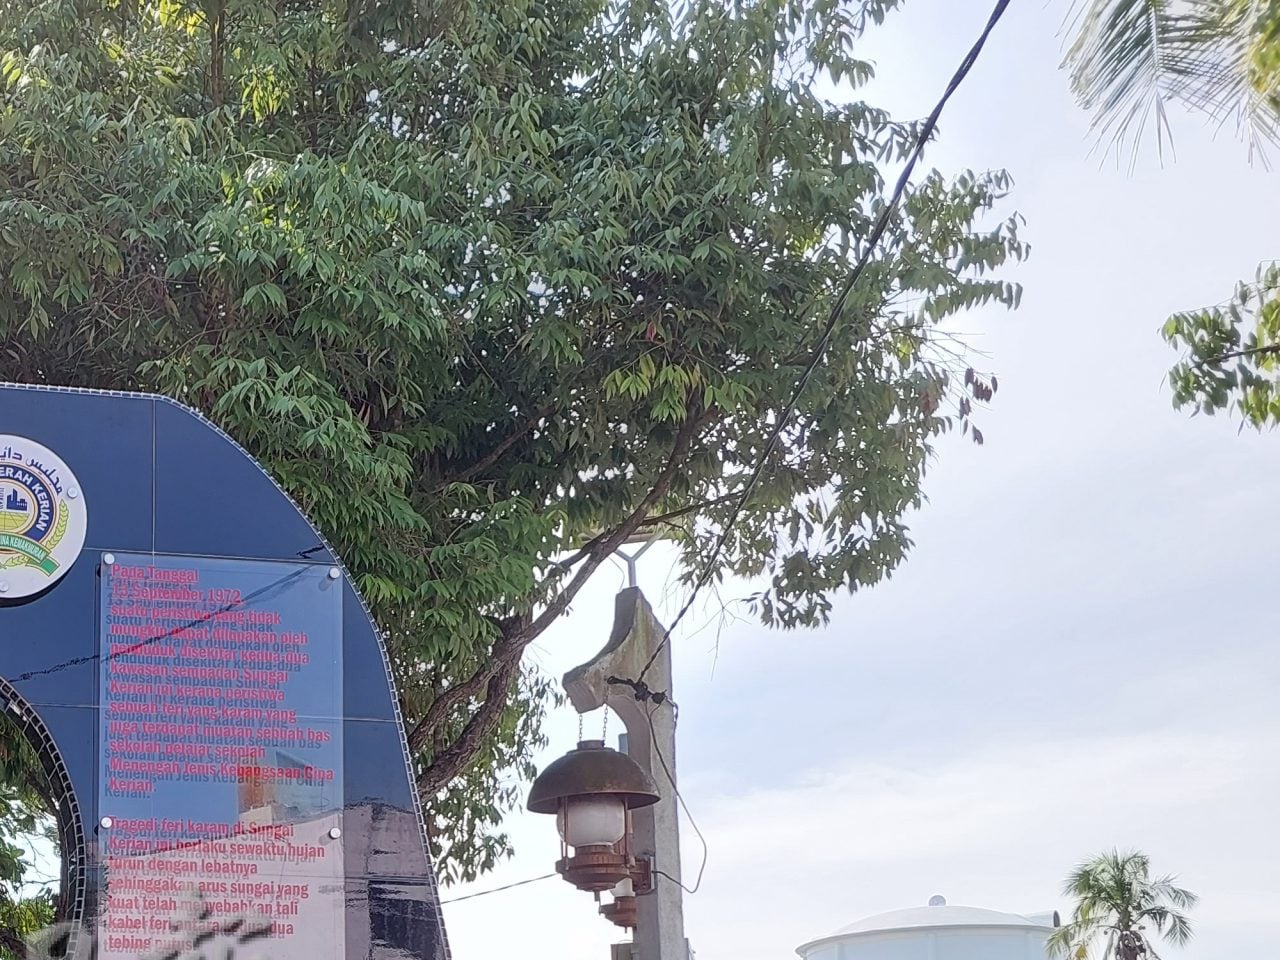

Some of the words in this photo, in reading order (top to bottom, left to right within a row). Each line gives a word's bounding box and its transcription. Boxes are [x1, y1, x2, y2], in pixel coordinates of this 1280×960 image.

[30, 482, 50, 532] KERIAN
[112, 564, 144, 579] Pada
[148, 566, 198, 583] Tanggal
[132, 584, 204, 601] September
[208, 589, 241, 604] 1972
[111, 605, 147, 617] suatu
[249, 610, 281, 624] tidak
[111, 625, 166, 640] mungkin
[213, 628, 276, 644] dilupakan
[281, 631, 308, 644] oleh
[181, 645, 237, 660] disekitar
[241, 650, 309, 664] kedua-dua
[111, 662, 168, 676] kawasan
[172, 666, 240, 680] sempadan
[244, 667, 288, 684] Sungai
[111, 681, 152, 695] Kerian
[158, 682, 173, 696] ini
[177, 684, 221, 698] kerana
[226, 687, 285, 701] peristiwa
[110, 701, 157, 714] sebuah
[162, 702, 183, 716] feri
[187, 706, 217, 720] yang
[222, 705, 261, 719] karam
[266, 710, 297, 724] yang
[110, 721, 137, 736] juga
[142, 722, 199, 737] terdapat
[203, 726, 252, 737] muatan
[256, 726, 303, 740] sebuah
[308, 727, 331, 741] bas
[110, 740, 160, 754] sekolah
[165, 742, 209, 757] pelajar
[214, 744, 265, 758] sekolah
[110, 758, 179, 775] Menengah
[184, 762, 216, 775] Jenis
[220, 763, 300, 781] Kebangsaan
[109, 817, 157, 833] Tragedi
[161, 818, 182, 832] feri
[187, 819, 229, 833] karam
[233, 821, 245, 835] di
[249, 822, 294, 839] Sungai
[110, 837, 151, 850] Kerian
[156, 838, 173, 852] ini
[177, 840, 226, 853] berlaku
[230, 843, 284, 856] sewaktu
[287, 843, 325, 859] hujan
[110, 856, 145, 870] turun
[149, 858, 197, 874] dengan
[202, 860, 257, 877] lebatnya
[109, 876, 195, 893] sehinggakan
[199, 881, 226, 892] arus
[231, 881, 274, 897] sungai
[277, 884, 308, 899] yang
[109, 895, 140, 909] kuat
[144, 897, 177, 910] telah
[276, 901, 298, 915] tali
[109, 915, 145, 929] kabel
[149, 916, 173, 930] feri
[109, 935, 151, 952] tebing
